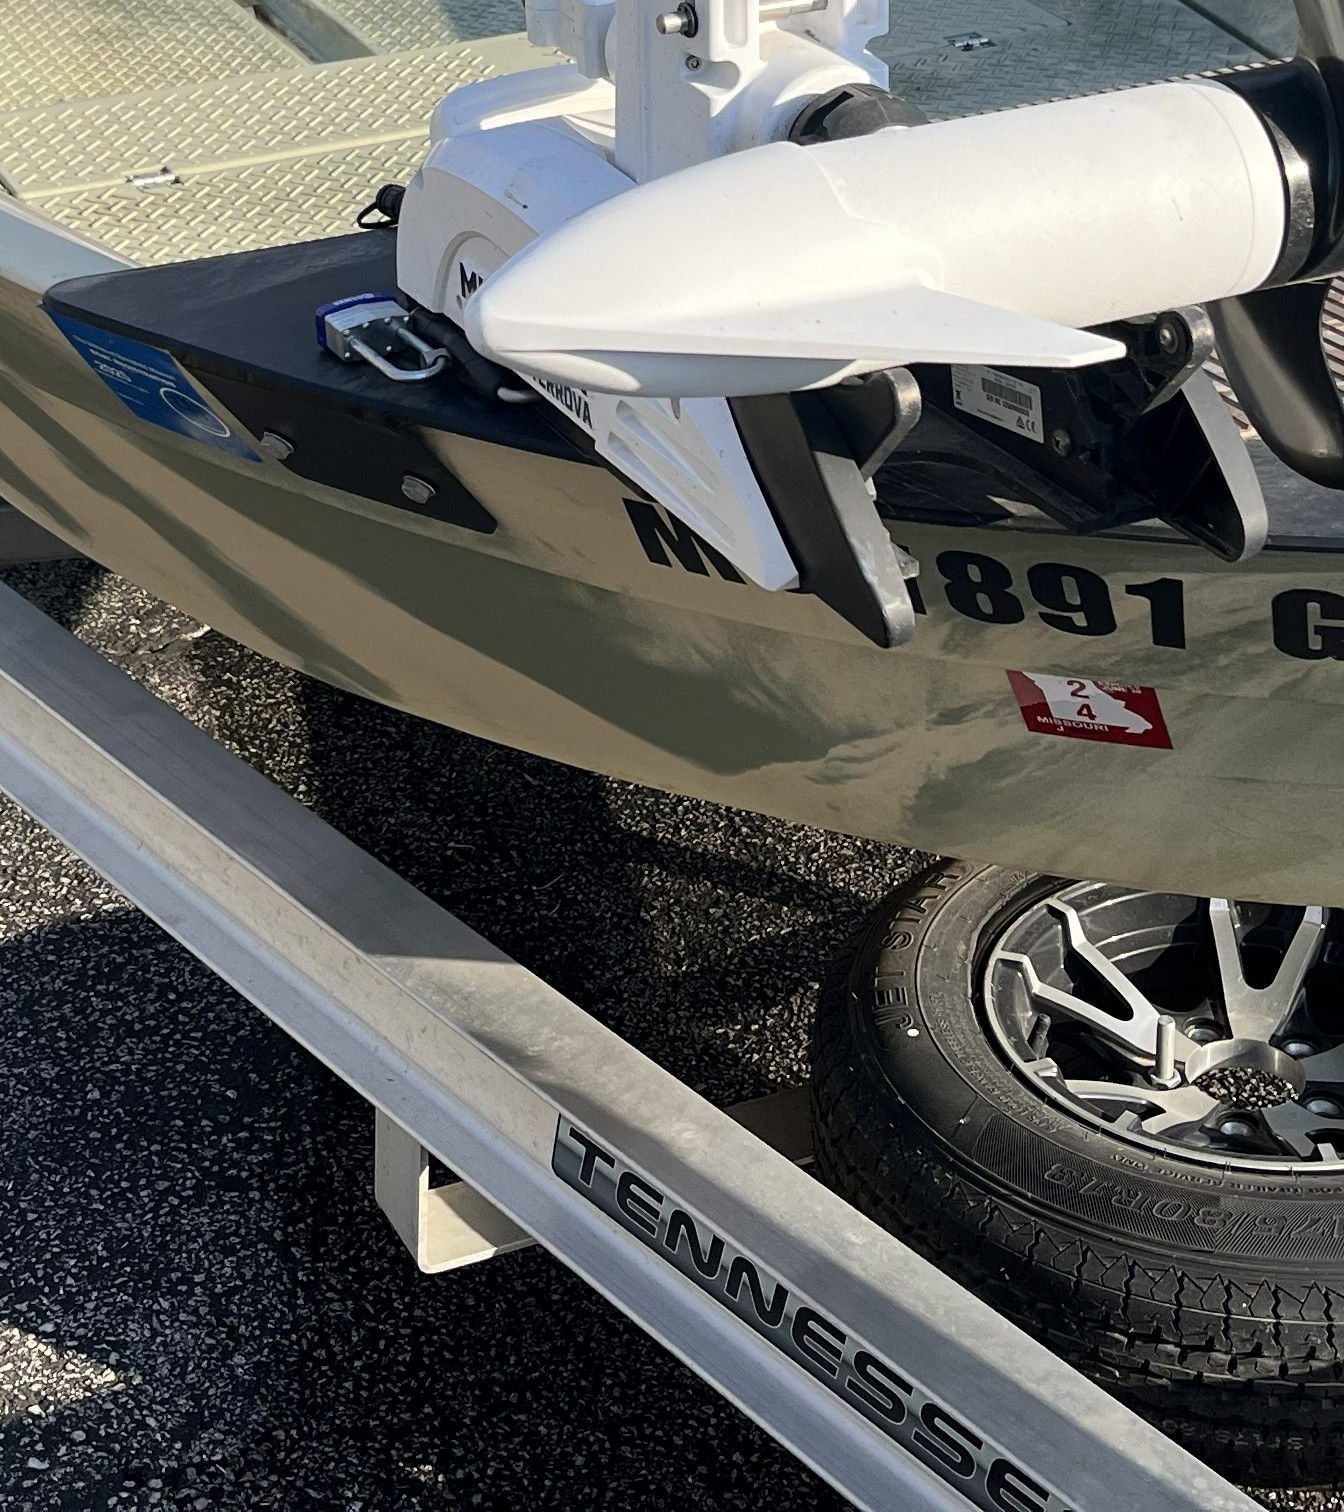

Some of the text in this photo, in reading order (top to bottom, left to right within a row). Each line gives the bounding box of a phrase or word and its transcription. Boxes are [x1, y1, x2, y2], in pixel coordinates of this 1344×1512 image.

[1065, 679, 1090, 700] 2
[1076, 703, 1098, 721] 4
[1036, 715, 1110, 733] MISSOURI
[871, 870, 961, 1030] JET STAR
[567, 1124, 1073, 1512] TENNESSE
